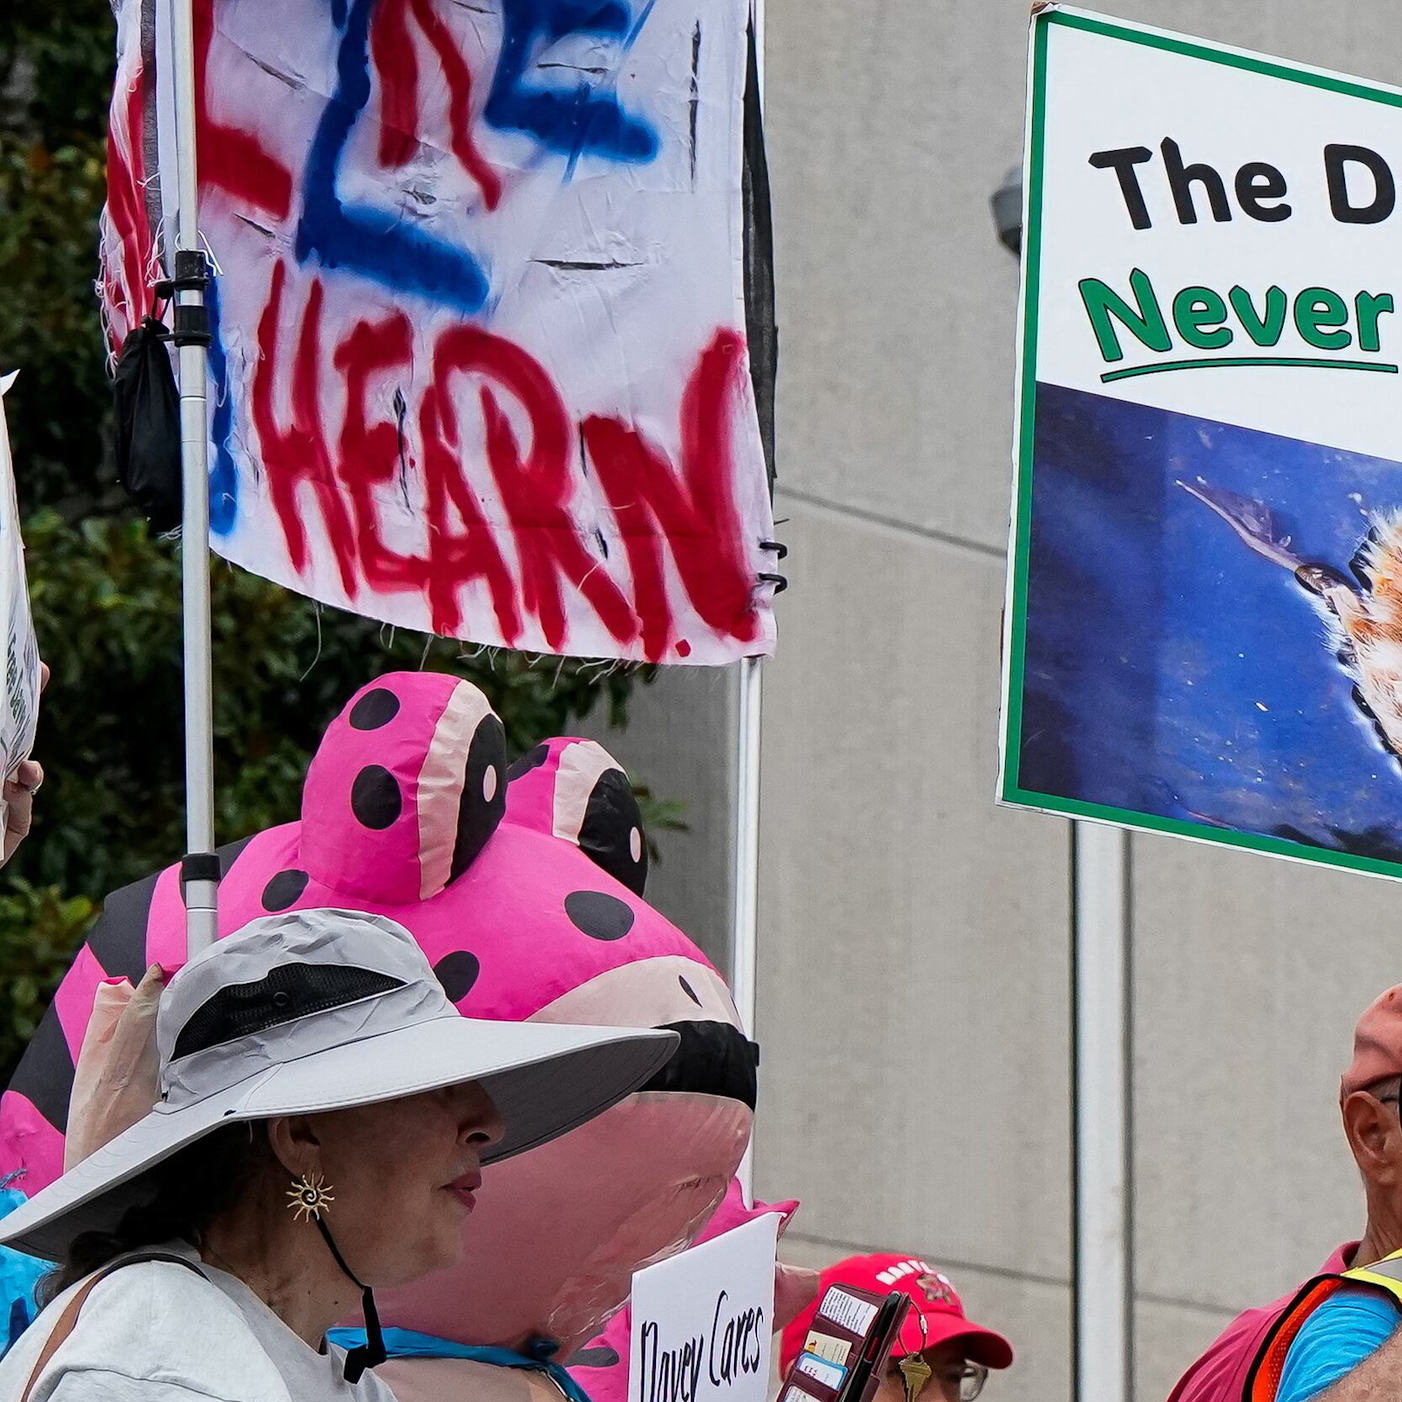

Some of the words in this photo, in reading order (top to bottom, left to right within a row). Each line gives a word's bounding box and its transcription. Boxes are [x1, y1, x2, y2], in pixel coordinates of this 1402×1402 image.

[1088, 137, 1291, 230] The
[1078, 268, 1394, 362] Never
[251, 261, 759, 663] HEARN
[709, 1290, 763, 1387] Cares
